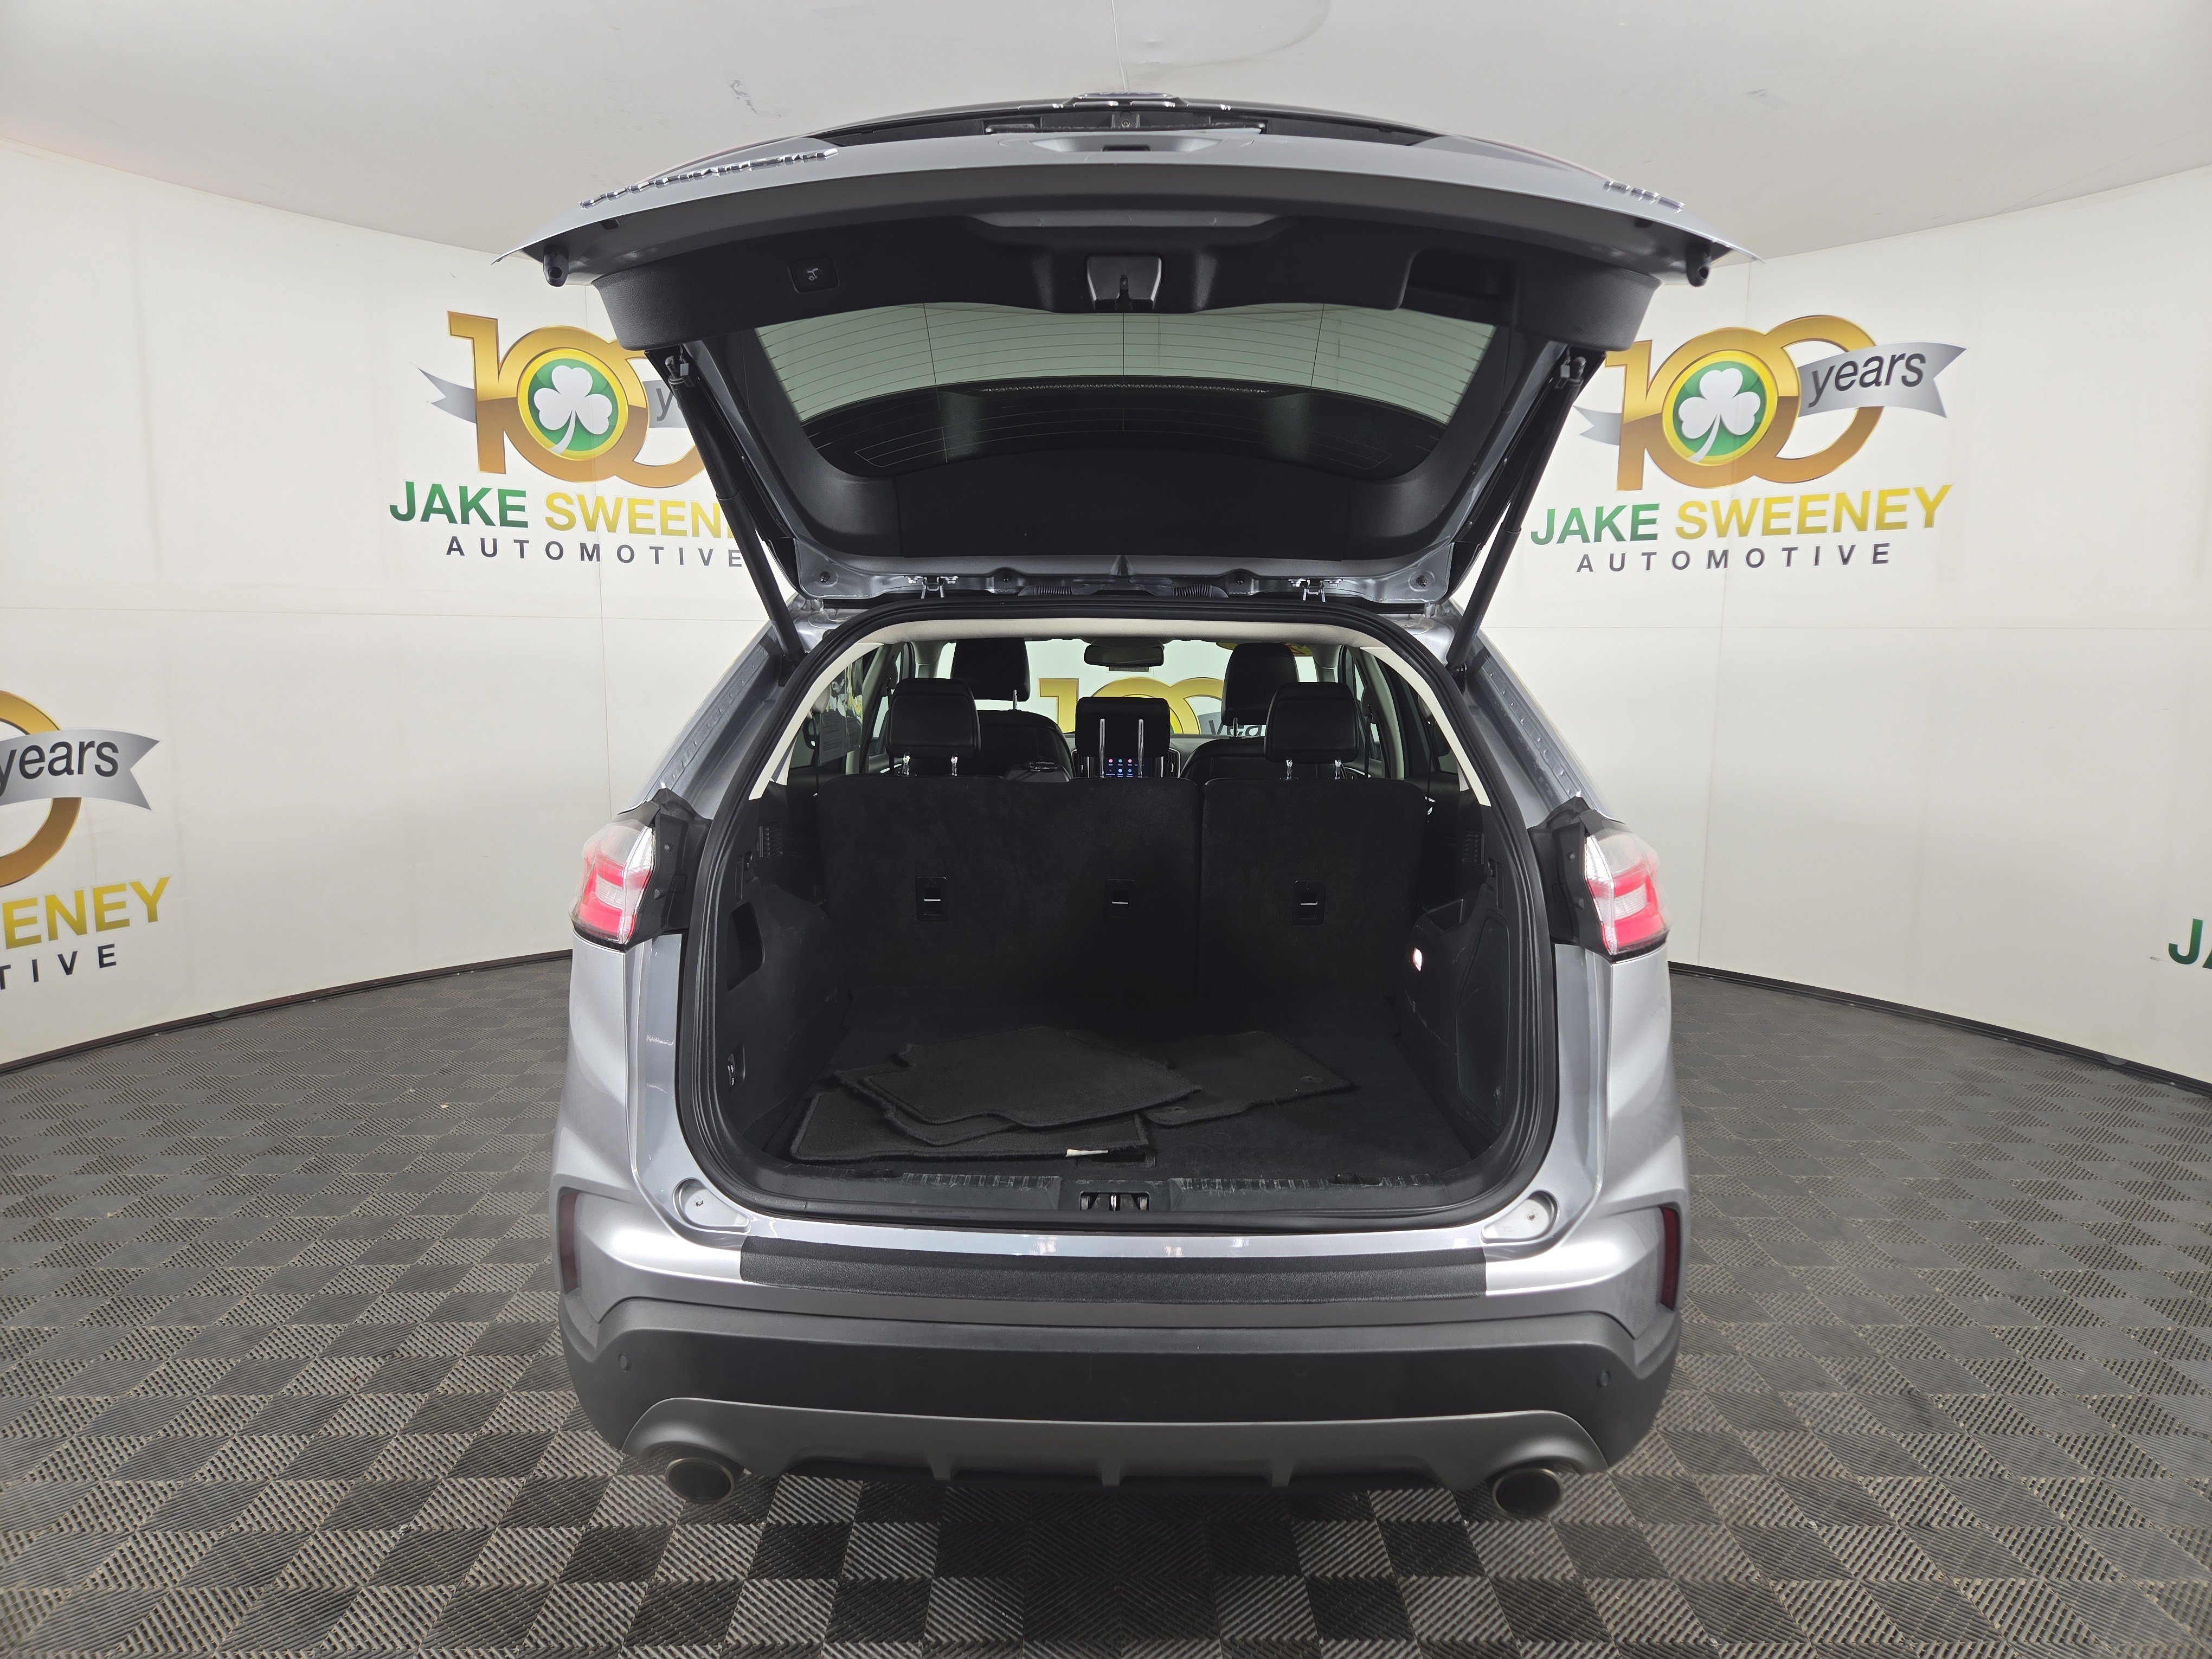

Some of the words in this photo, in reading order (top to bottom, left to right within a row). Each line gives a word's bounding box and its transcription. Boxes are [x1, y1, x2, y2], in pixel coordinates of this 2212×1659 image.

[1604, 314, 1886, 491] 100
[1808, 352, 1926, 408] years
[389, 481, 529, 528] JAKE
[544, 492, 734, 539] SWEEN
[1531, 503, 1660, 545] JAKE
[1675, 484, 1953, 539] SWEENEY
[446, 536, 742, 567] AUTOMOTIVE
[1576, 543, 1890, 573] AUTOMOTIVE
